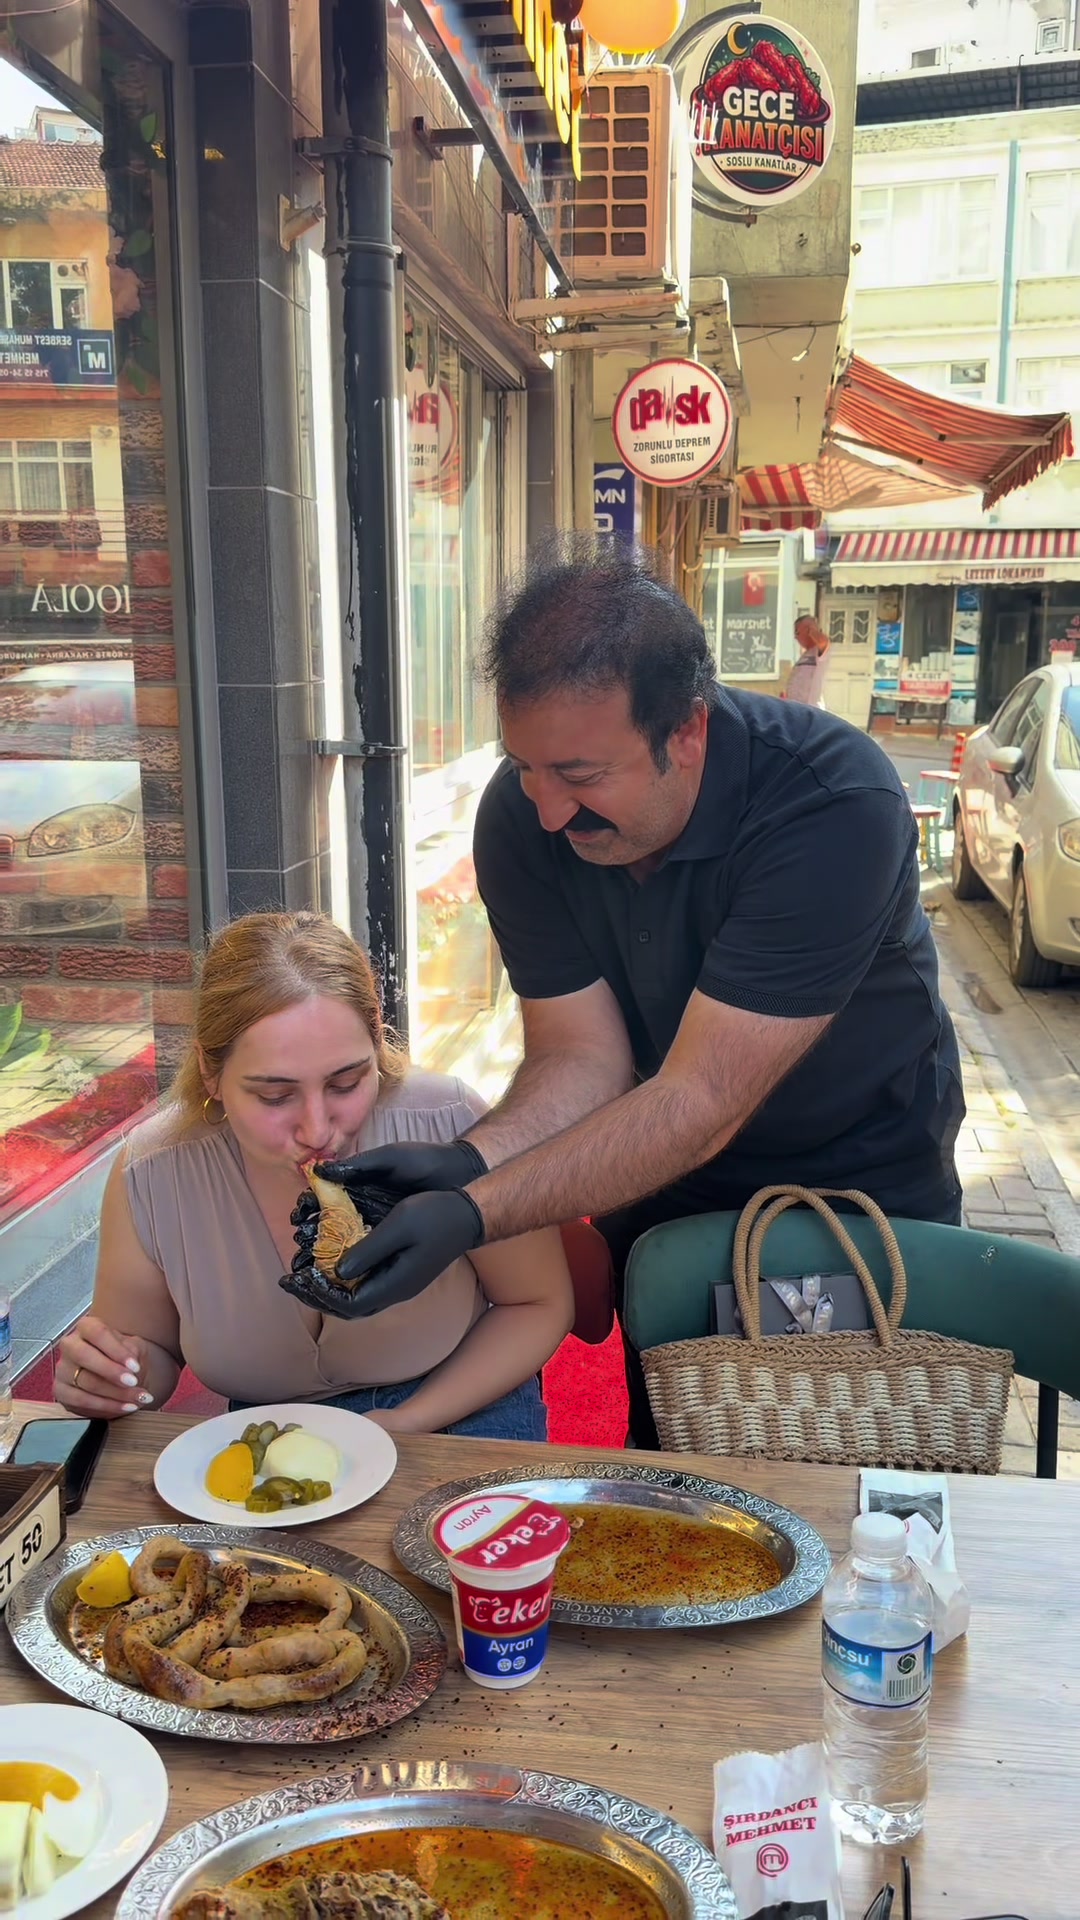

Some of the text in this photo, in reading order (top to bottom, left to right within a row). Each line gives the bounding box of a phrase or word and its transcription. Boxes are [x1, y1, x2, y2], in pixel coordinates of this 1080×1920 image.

[722, 86, 795, 121] GECE
[726, 156, 797, 173] SOSLU KANATLAR
[633, 436, 711, 452] ZORUNLU DEPREM
[650, 452, 695, 464] SİGORTASI
[453, 1504, 492, 1532] Ayran
[22, 1522, 42, 1565] 50
[571, 1612, 614, 1625] GECE
[488, 1637, 534, 1656] Ayran
[723, 1797, 818, 1829] ŞIRDANCI
[725, 1816, 817, 1847] MEHMET
